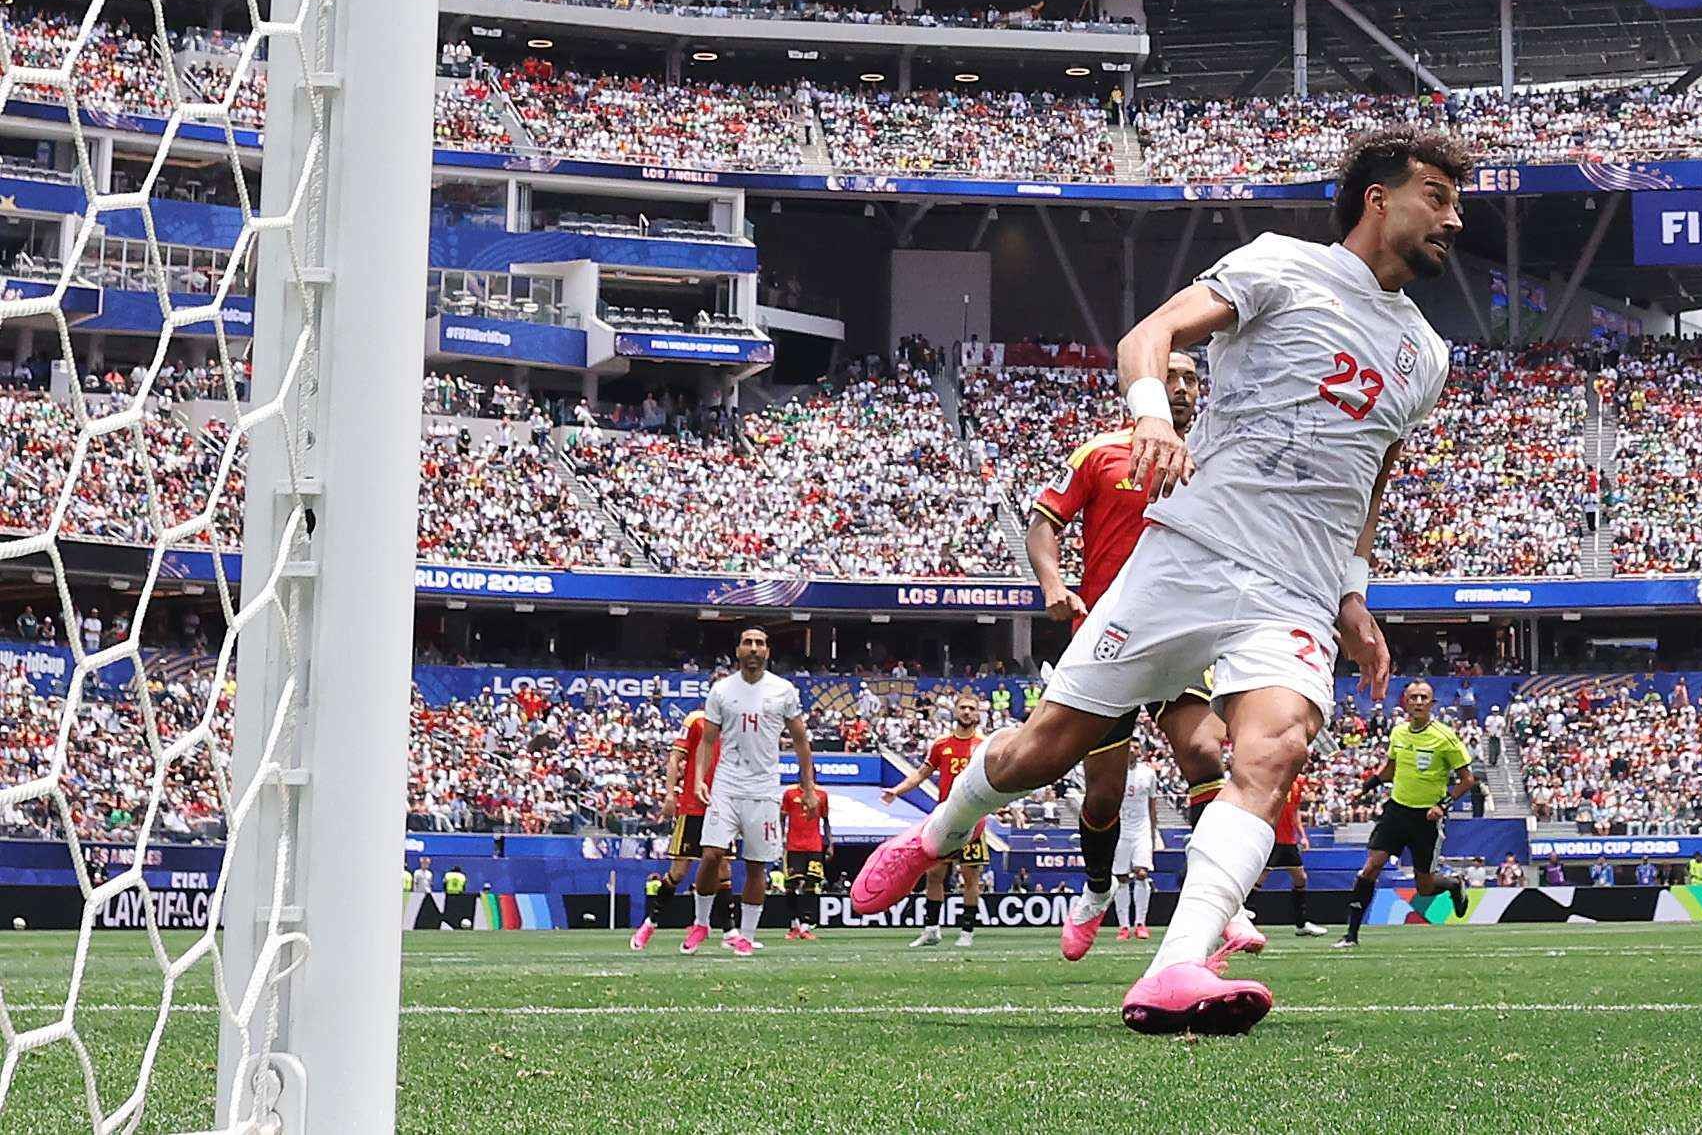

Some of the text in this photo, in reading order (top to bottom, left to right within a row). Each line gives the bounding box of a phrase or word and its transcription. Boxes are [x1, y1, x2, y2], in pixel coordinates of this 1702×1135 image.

[1319, 351, 1385, 420] 23
[450, 571, 487, 591] CUP
[487, 574, 554, 594] 2026
[898, 587, 1034, 606] LOS ANGELES
[741, 712, 759, 733] 14
[763, 821, 777, 841] 14
[963, 842, 982, 861] 23
[1553, 842, 1602, 855] WORLD
[1603, 841, 1630, 854] CUP
[1036, 855, 1064, 867] LOS
